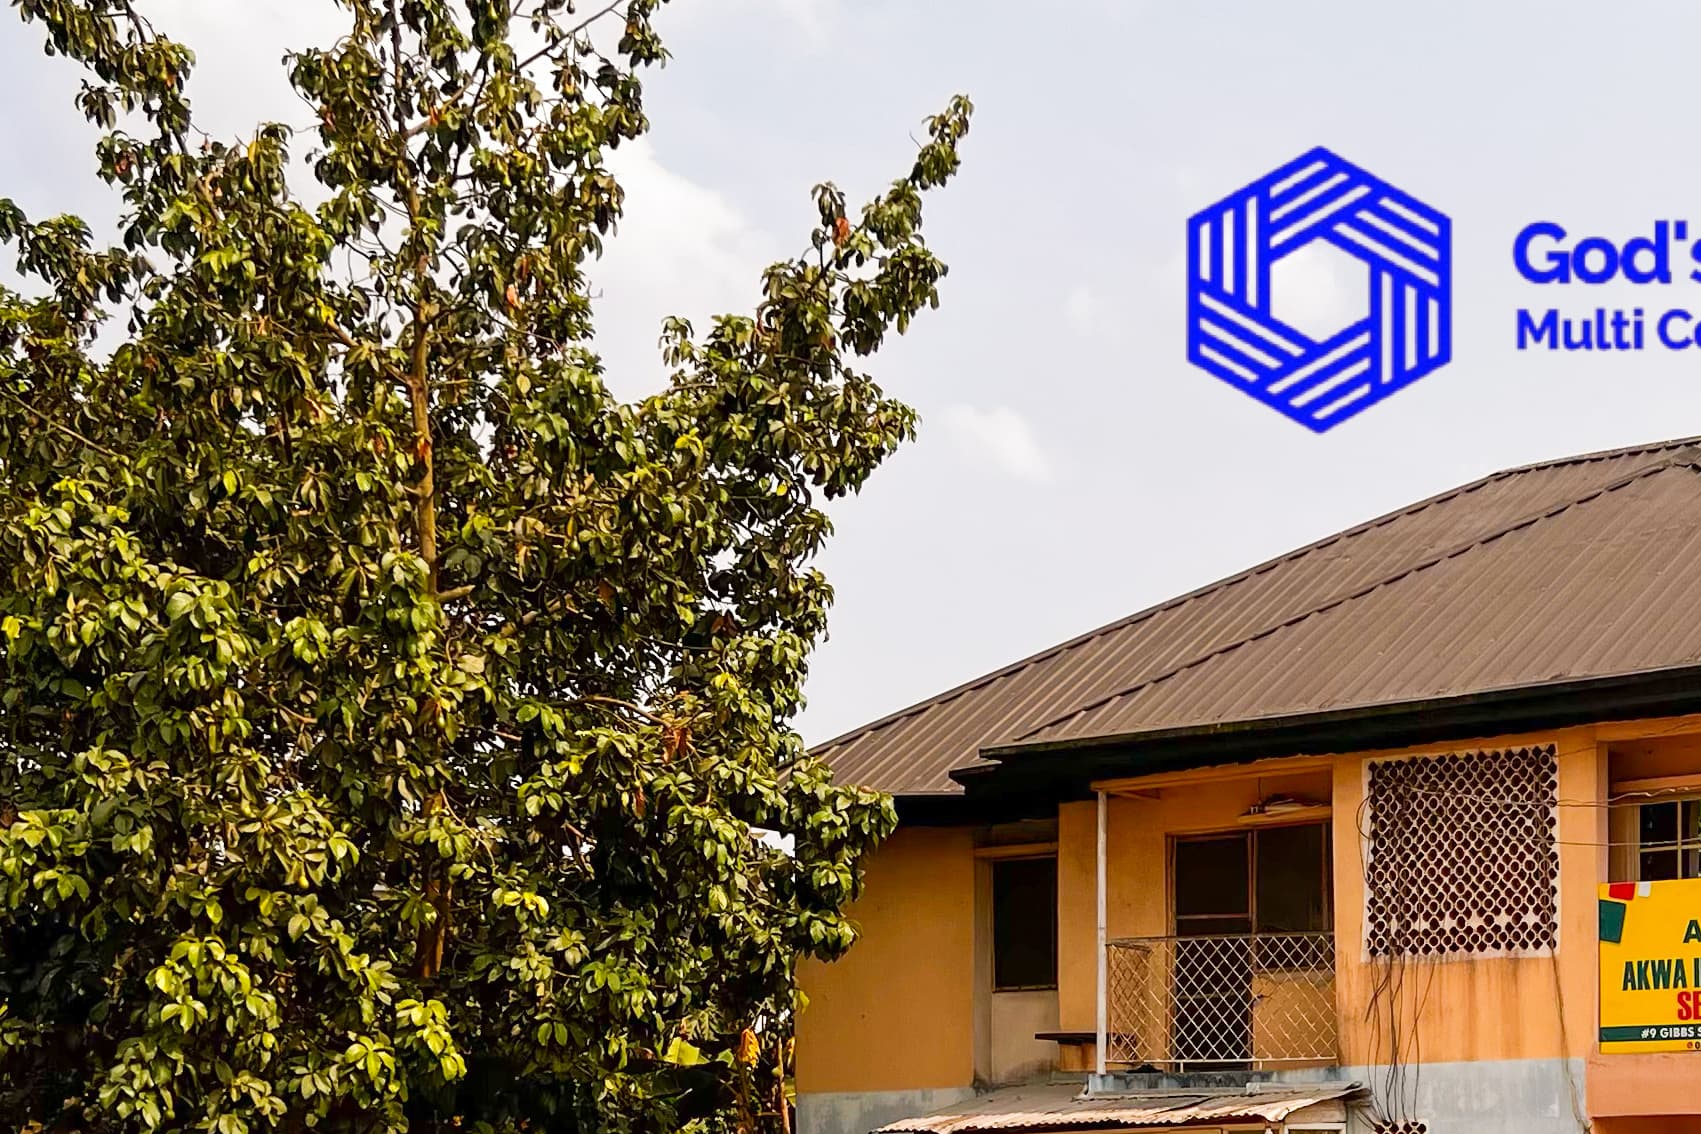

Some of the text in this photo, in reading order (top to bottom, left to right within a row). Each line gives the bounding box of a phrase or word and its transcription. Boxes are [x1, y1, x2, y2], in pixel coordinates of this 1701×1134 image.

[1622, 958, 1686, 992] AKWA
[1641, 1029, 1657, 1039] #9
[1659, 1026, 1695, 1039] GIBBS
